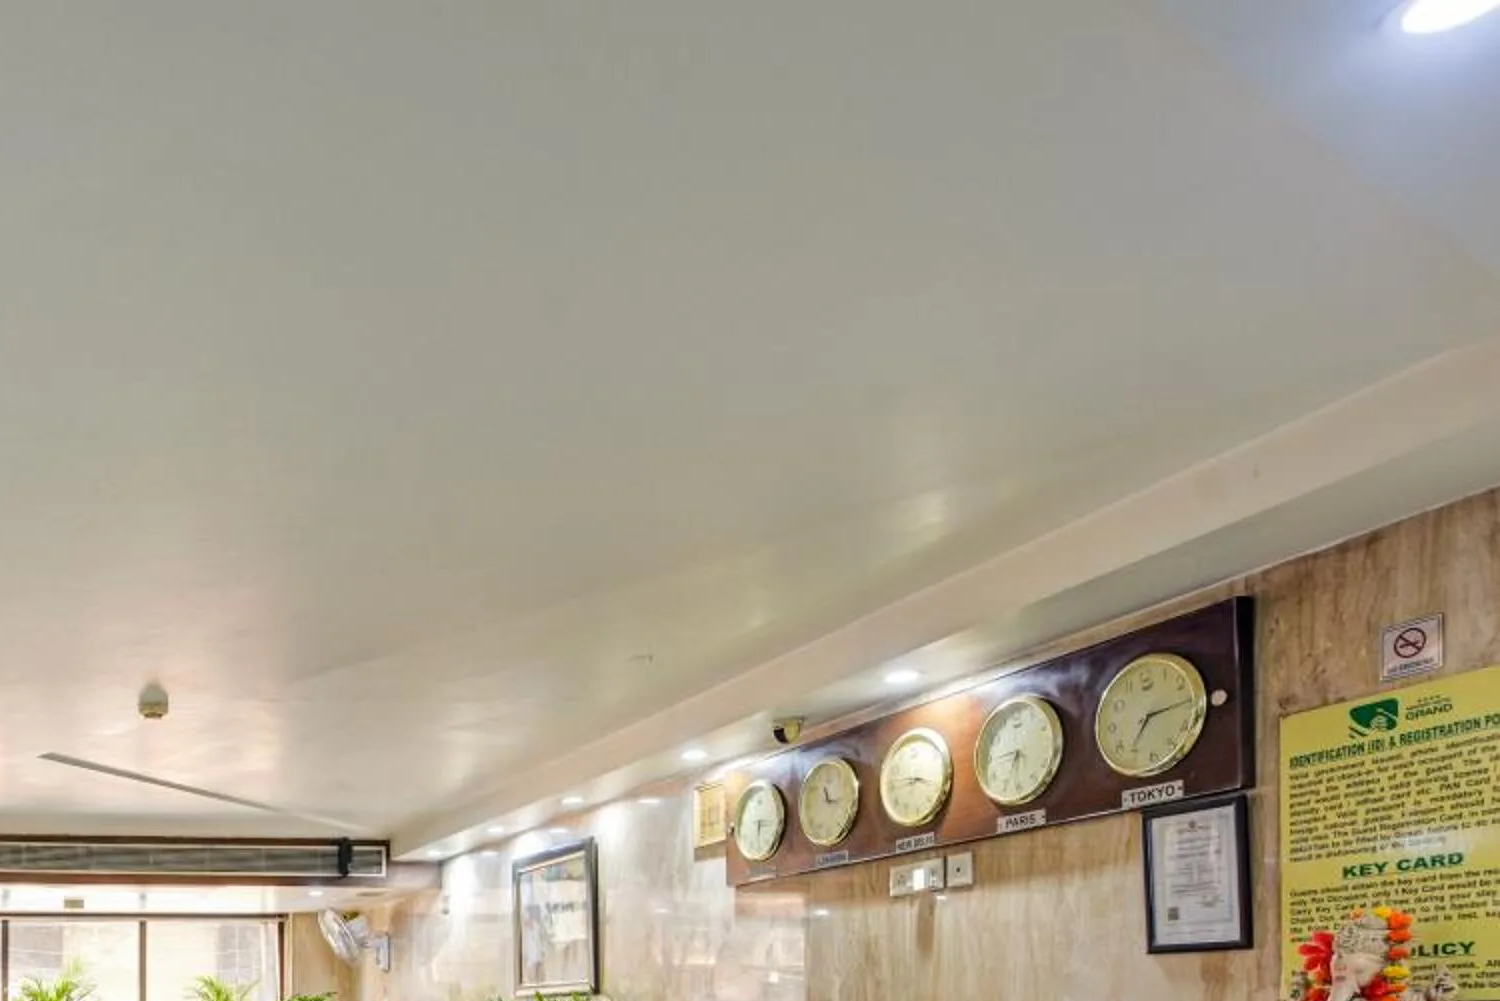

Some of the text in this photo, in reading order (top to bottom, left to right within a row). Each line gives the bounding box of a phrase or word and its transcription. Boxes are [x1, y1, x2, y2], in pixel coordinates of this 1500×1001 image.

[1406, 703, 1453, 722] GRAND
[1290, 741, 1364, 769] IDENTIFICATION
[1400, 718, 1481, 746] REGISTRATION
[1130, 784, 1176, 804] TOKYO
[1005, 813, 1037, 831] PARIS
[1343, 861, 1389, 879] KEY
[1396, 852, 1465, 871] CARD
[1411, 940, 1475, 957] LICY
